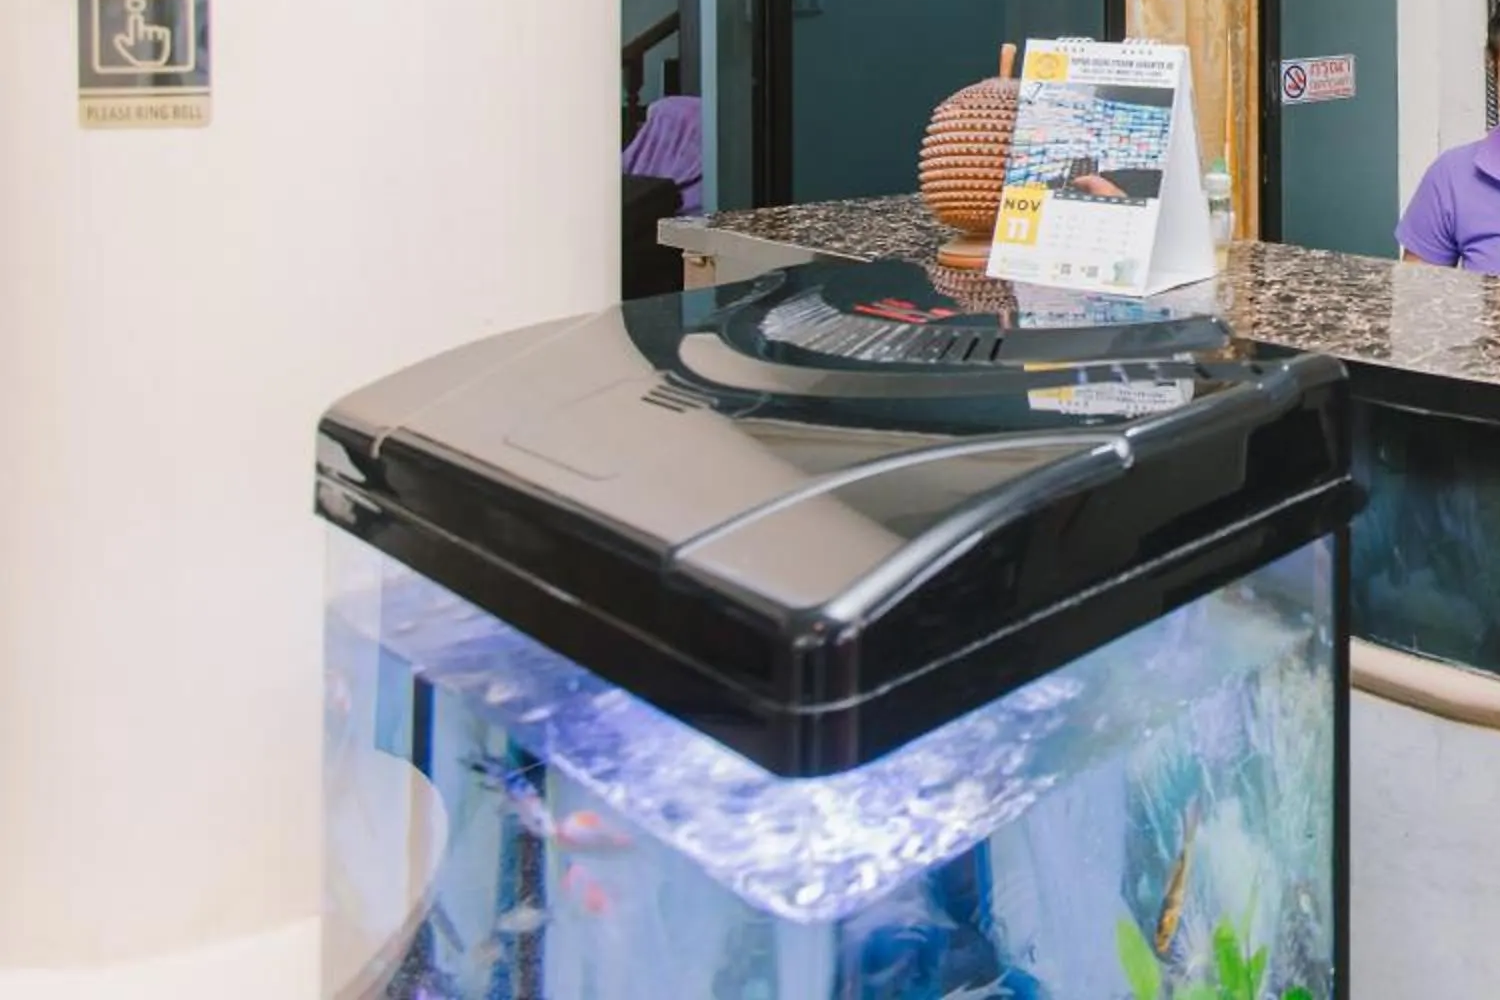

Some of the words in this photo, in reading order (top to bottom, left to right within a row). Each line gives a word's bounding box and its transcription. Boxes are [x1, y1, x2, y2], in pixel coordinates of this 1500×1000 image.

[86, 104, 131, 121] PLEASE
[136, 105, 170, 120] RING
[173, 104, 203, 120] BELL
[1003, 198, 1042, 212] NOV
